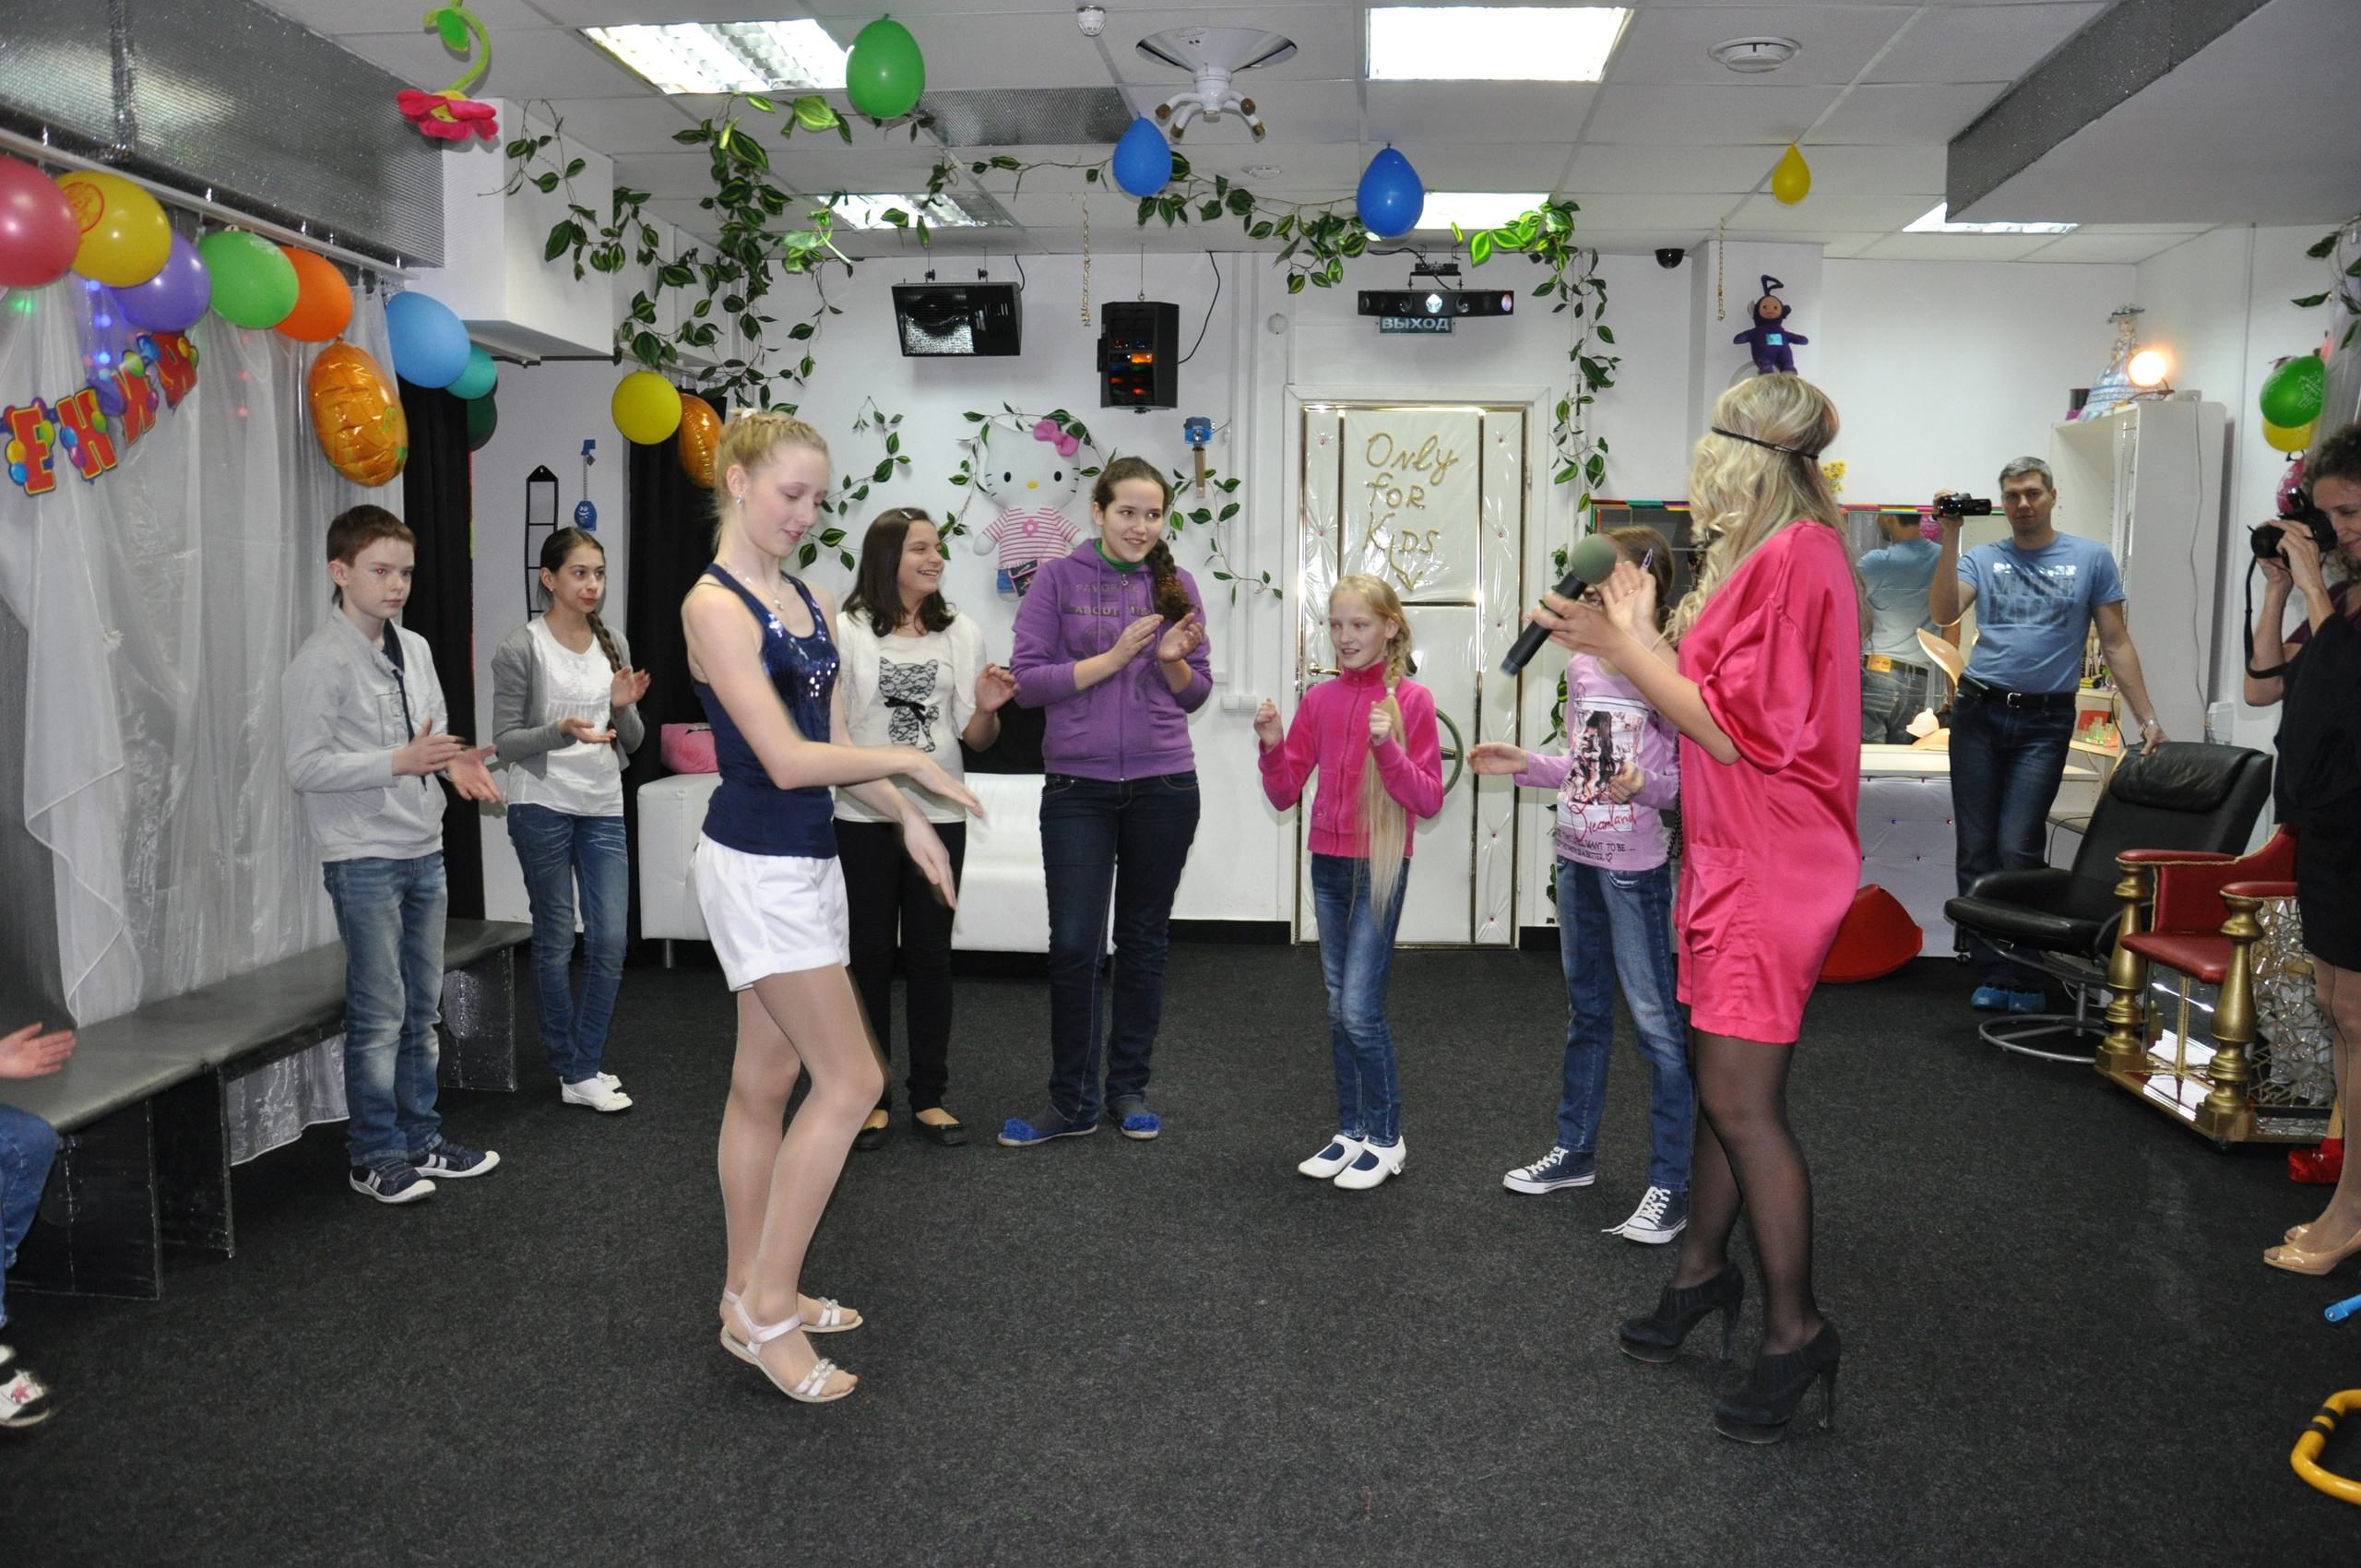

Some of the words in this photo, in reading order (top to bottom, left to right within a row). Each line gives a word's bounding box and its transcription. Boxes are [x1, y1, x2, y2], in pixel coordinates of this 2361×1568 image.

[1382, 317, 1450, 330] ВЫХОД
[1366, 433, 1459, 485] Only
[1606, 842, 1616, 852] TO
[1616, 843, 1627, 852] BE
